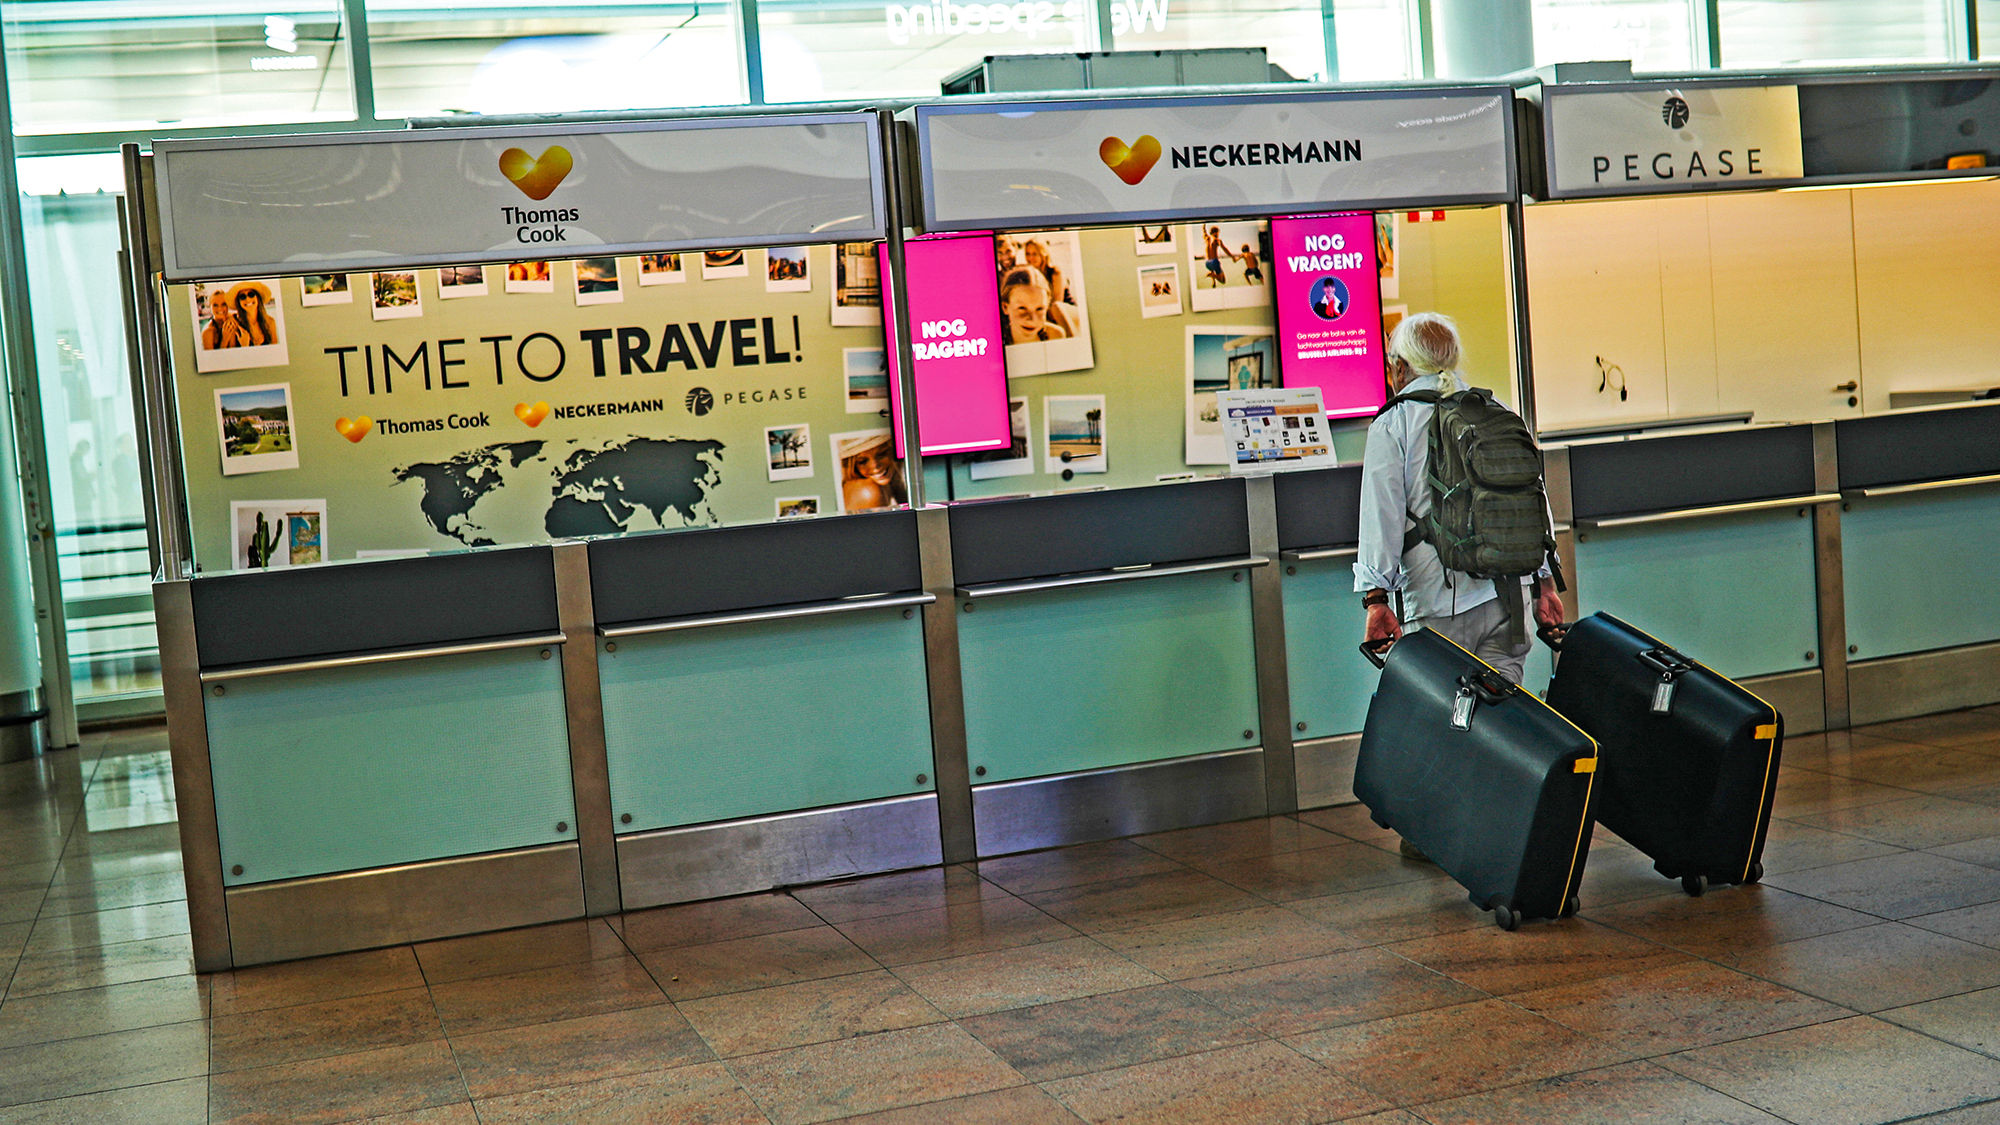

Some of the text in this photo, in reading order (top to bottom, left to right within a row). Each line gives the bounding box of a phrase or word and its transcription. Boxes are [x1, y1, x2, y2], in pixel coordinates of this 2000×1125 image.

[1171, 139, 1362, 169] NECKERMANN
[1593, 148, 1763, 183] PEGASE
[501, 206, 580, 225] Thomas
[516, 224, 567, 244] Cook
[1304, 233, 1346, 252] NOG
[1287, 252, 1364, 273] VRAGEN?
[921, 318, 968, 339] NOG
[323, 314, 803, 397] TIME TO TRAVEL!
[911, 337, 988, 361] RAGEN?
[723, 386, 808, 405] PEGASE
[554, 399, 664, 420] NECKERMANN
[376, 411, 490, 435] Thomas Cook
